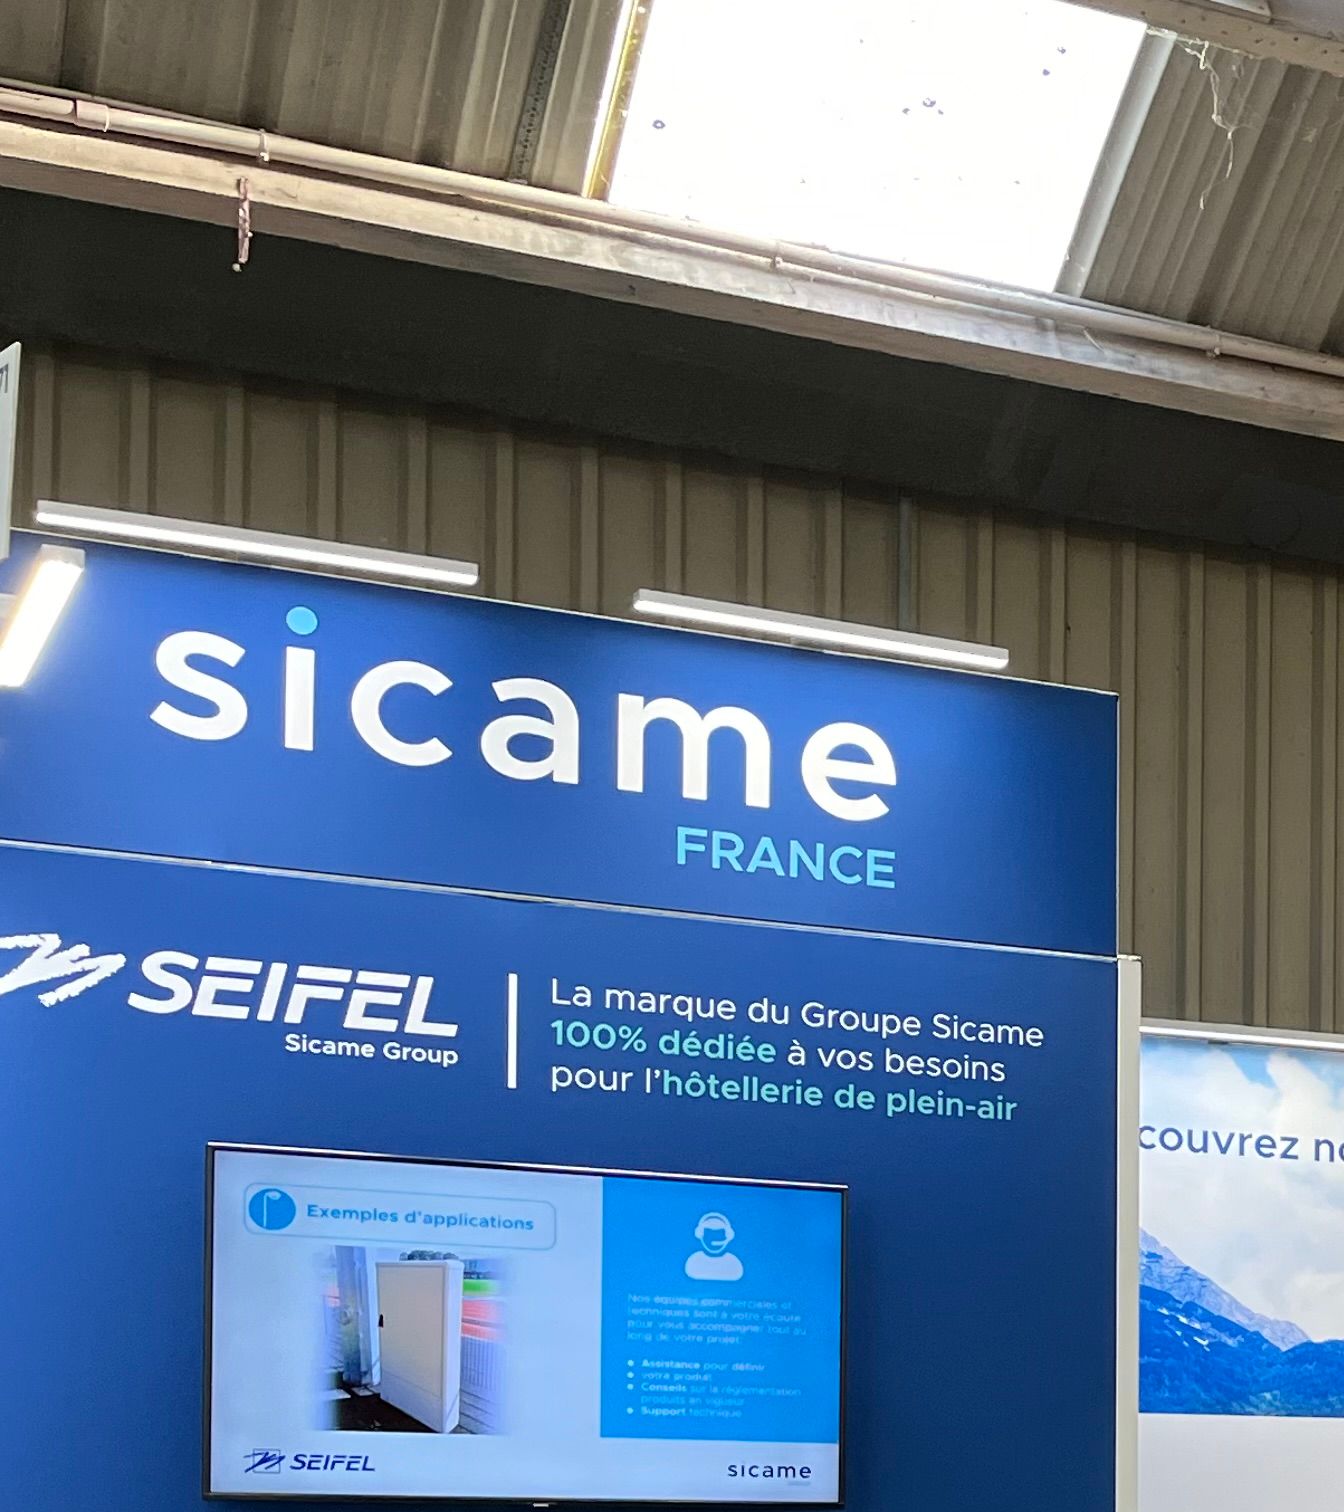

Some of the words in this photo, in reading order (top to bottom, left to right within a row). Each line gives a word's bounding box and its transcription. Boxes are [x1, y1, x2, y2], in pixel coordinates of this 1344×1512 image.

[150, 606, 898, 821] sicame
[675, 825, 896, 888] FRANCE
[127, 951, 458, 1037] SEIFEL
[552, 978, 592, 1007] La
[605, 987, 736, 1022] marque
[748, 998, 789, 1024] du
[801, 1001, 921, 1039] Groupe
[932, 1013, 1044, 1047] Sicame
[285, 1033, 375, 1059] Sicame
[382, 1041, 459, 1067] Group
[551, 1020, 647, 1053] 100%
[658, 1029, 776, 1063] dédiée
[787, 1040, 806, 1066] à
[817, 1048, 873, 1071] vos
[885, 1048, 1006, 1082] besoins
[552, 1065, 633, 1092] pour
[646, 1067, 823, 1106] l'hôtellerie
[834, 1084, 875, 1110] de
[886, 1088, 1018, 1121] plein-air
[1138, 1125, 1299, 1160] couvrez
[307, 1204, 399, 1224] Exemples
[404, 1210, 535, 1232] d'applications
[289, 1454, 376, 1472] SEIFEL
[727, 1463, 812, 1479] sicame
